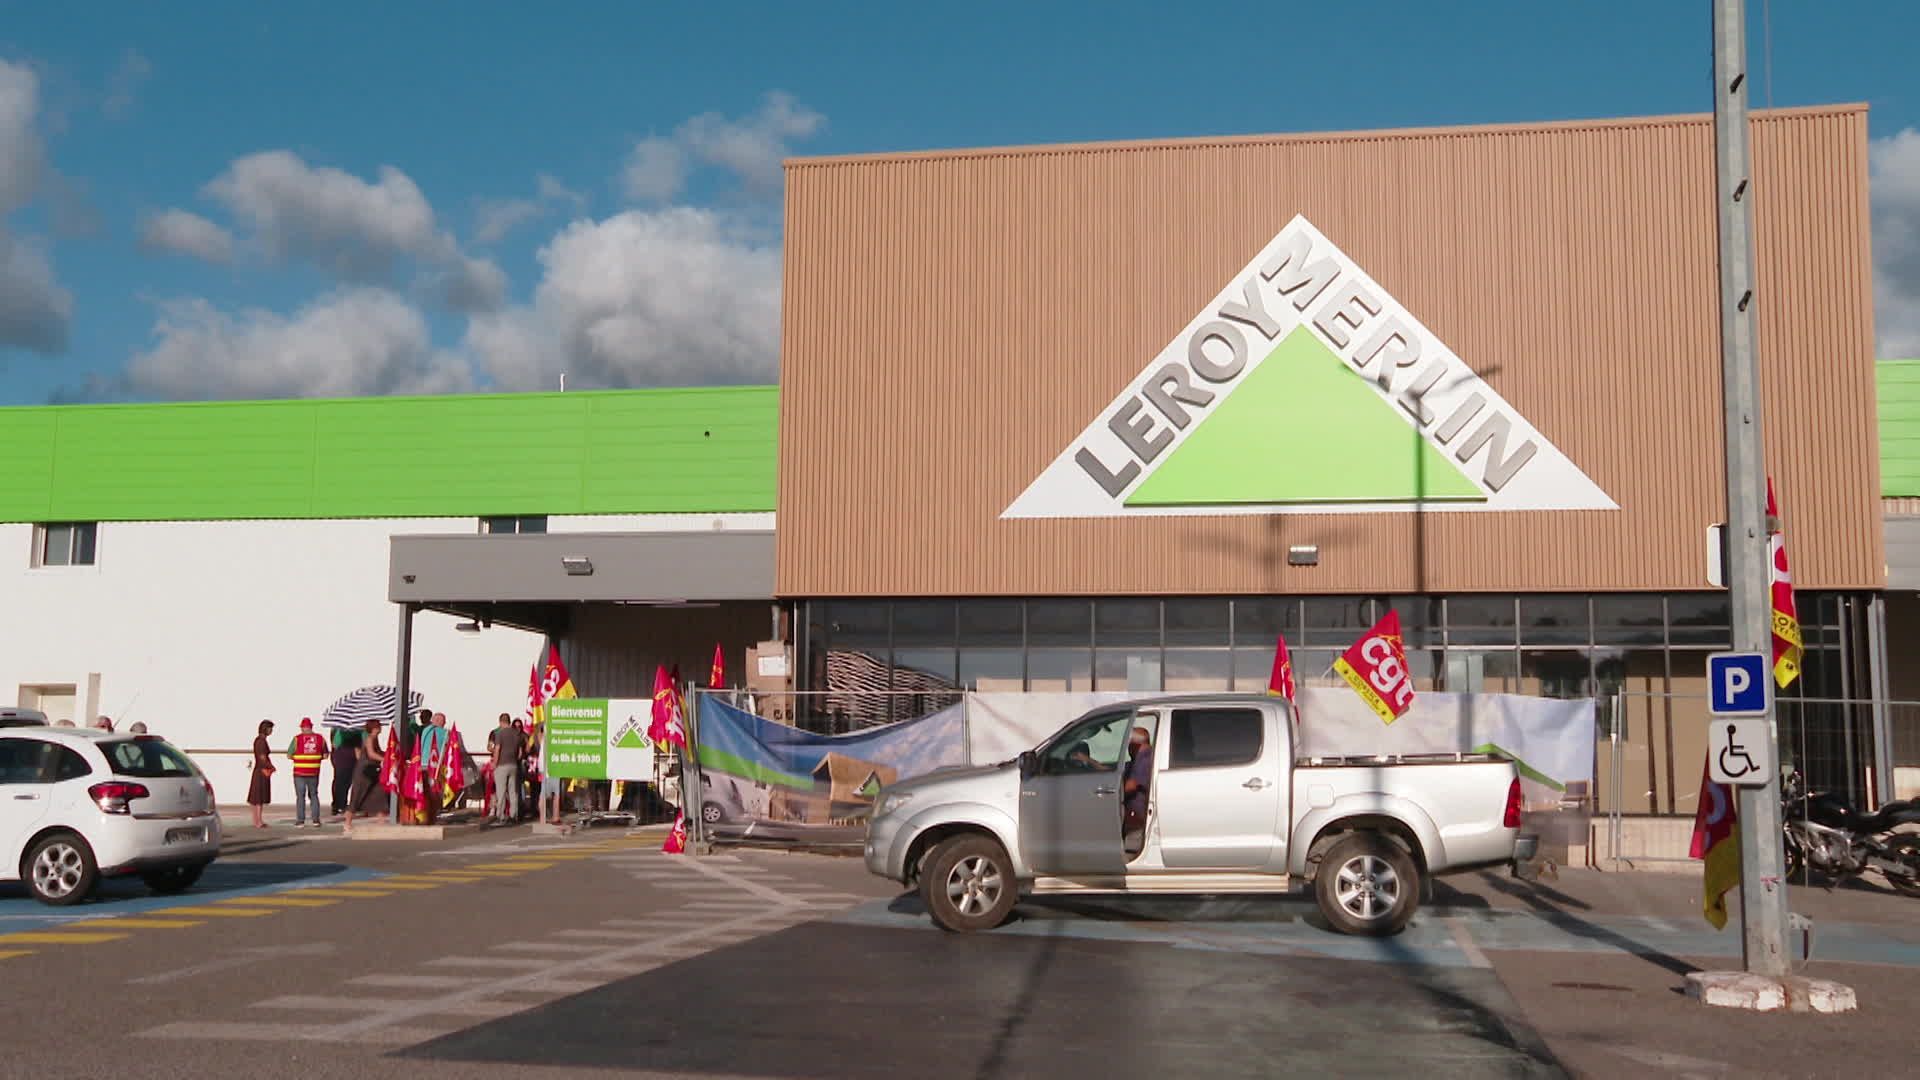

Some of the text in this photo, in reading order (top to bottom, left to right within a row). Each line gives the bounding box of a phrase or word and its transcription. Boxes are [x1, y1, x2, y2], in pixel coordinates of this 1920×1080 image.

[1075, 229, 1538, 498] LEROY MERLIN
[1361, 637, 1413, 706] cgt
[1725, 667, 1750, 704] P
[551, 704, 602, 718] Bienvenue
